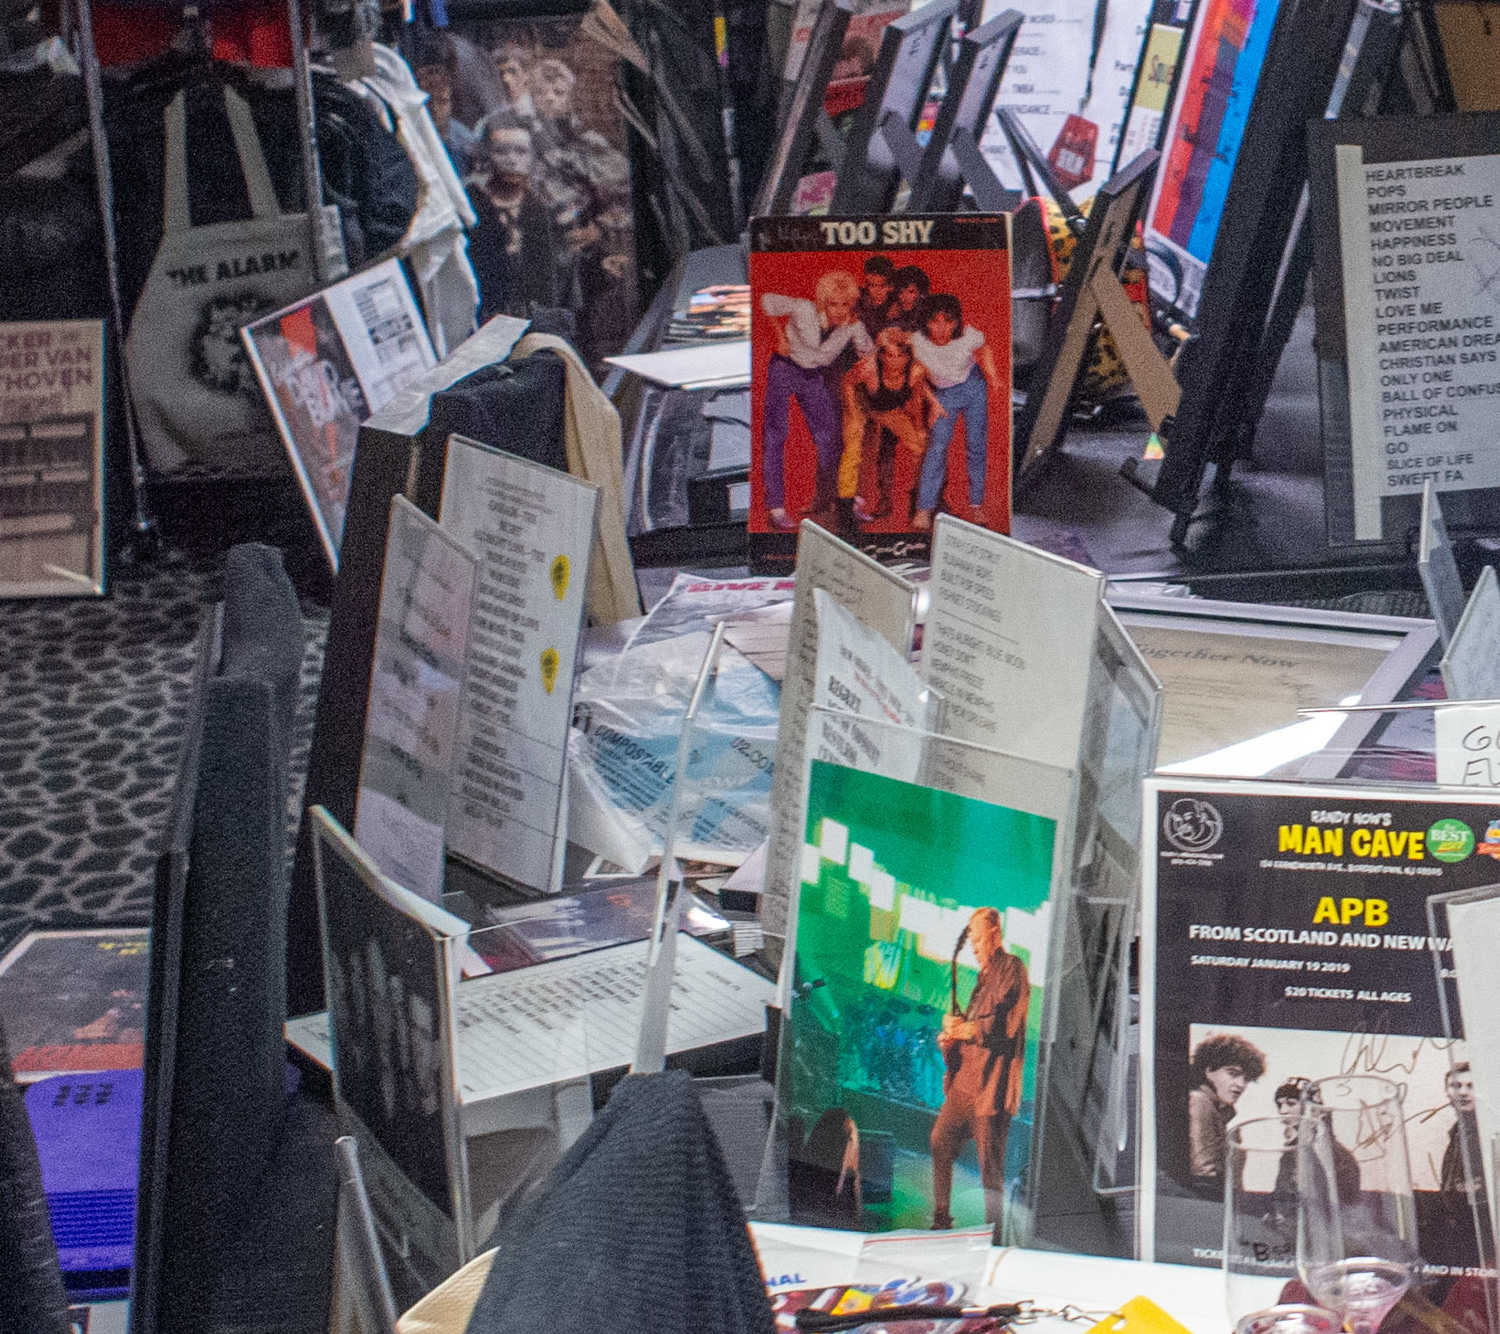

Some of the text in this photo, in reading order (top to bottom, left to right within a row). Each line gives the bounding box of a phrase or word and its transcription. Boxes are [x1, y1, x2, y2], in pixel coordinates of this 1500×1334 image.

[1365, 165, 1465, 182] HEARTBREAK
[1367, 185, 1406, 198] POPS
[1368, 195, 1493, 215] MIRROR PEOPLE
[820, 220, 935, 245] TOO SHY
[1370, 216, 1455, 233] MOVEMENT
[1371, 233, 1457, 251] HAPPINESS
[1372, 250, 1464, 267] NO BIG DEAL
[166, 251, 300, 291] THE ALARM
[1373, 270, 1416, 284] LIONS
[1375, 286, 1420, 301] TWIST
[1376, 303, 1443, 318] LOVE ME
[1377, 317, 1494, 336] PERFORMANCE
[1378, 336, 1459, 354] AMERICAN
[41, 347, 92, 366] VAN
[1379, 351, 1497, 370] CHRISTIAN SAYS
[1380, 371, 1453, 387] ONLY ONE
[1382, 389, 1420, 403] BALL
[1423, 387, 1442, 401] OF
[1383, 405, 1458, 421] PHYSICAL
[1384, 421, 1457, 437] FLAME ON
[1385, 441, 1409, 455] GO
[1387, 453, 1474, 471] SLICE OF LIFE
[594, 724, 677, 785] COMPOSTABLE
[1311, 810, 1351, 825] RANDY
[1278, 824, 1426, 860] MAN CAVE
[1431, 828, 1469, 843] BEST
[1312, 896, 1389, 927] APB
[1189, 925, 1424, 951] FROM SCOTLAND AND NEW
[1191, 955, 1350, 973] SATURDAY JANUARY 19 2019
[1308, 987, 1354, 1000] TICKETS
[1356, 989, 1378, 1001] ALL
[1380, 991, 1411, 1003] AGES
[1464, 1267, 1498, 1279] STOR
